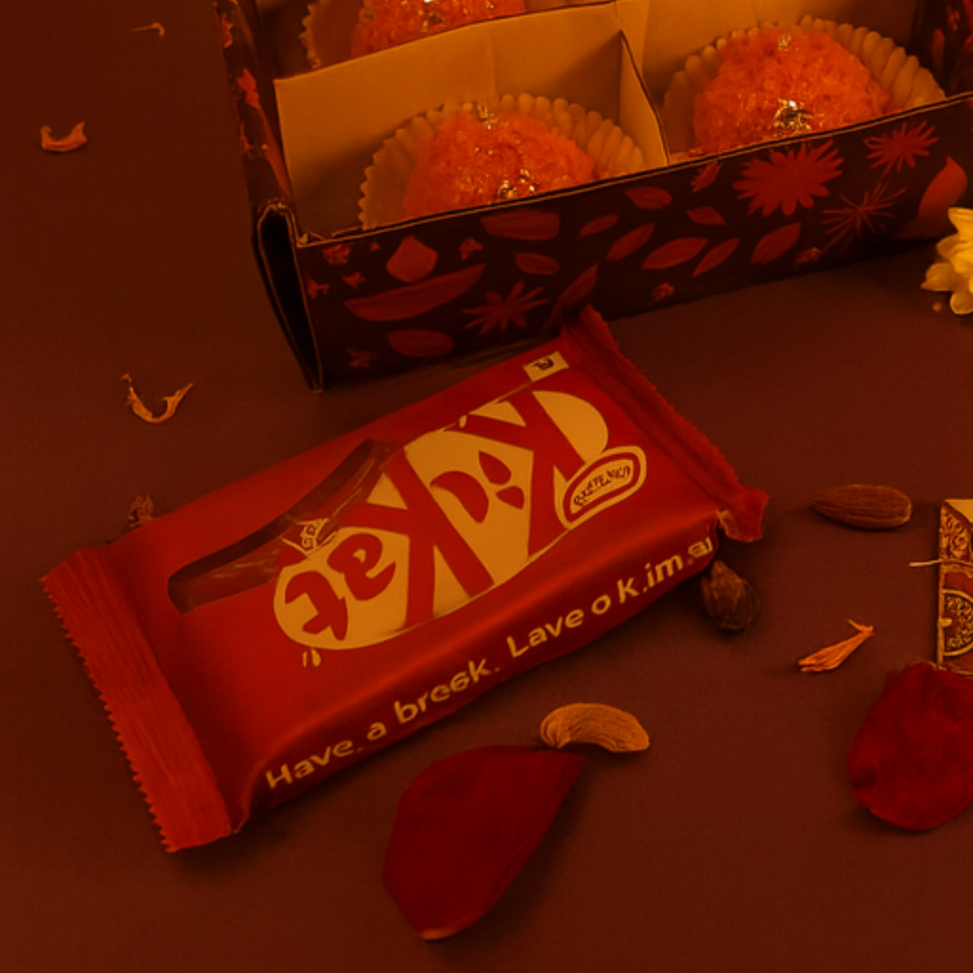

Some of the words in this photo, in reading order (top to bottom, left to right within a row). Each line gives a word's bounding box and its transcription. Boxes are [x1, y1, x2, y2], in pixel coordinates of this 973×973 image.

[366, 721, 388, 742] a
[506, 607, 585, 658] Lave
[590, 594, 612, 616] o
